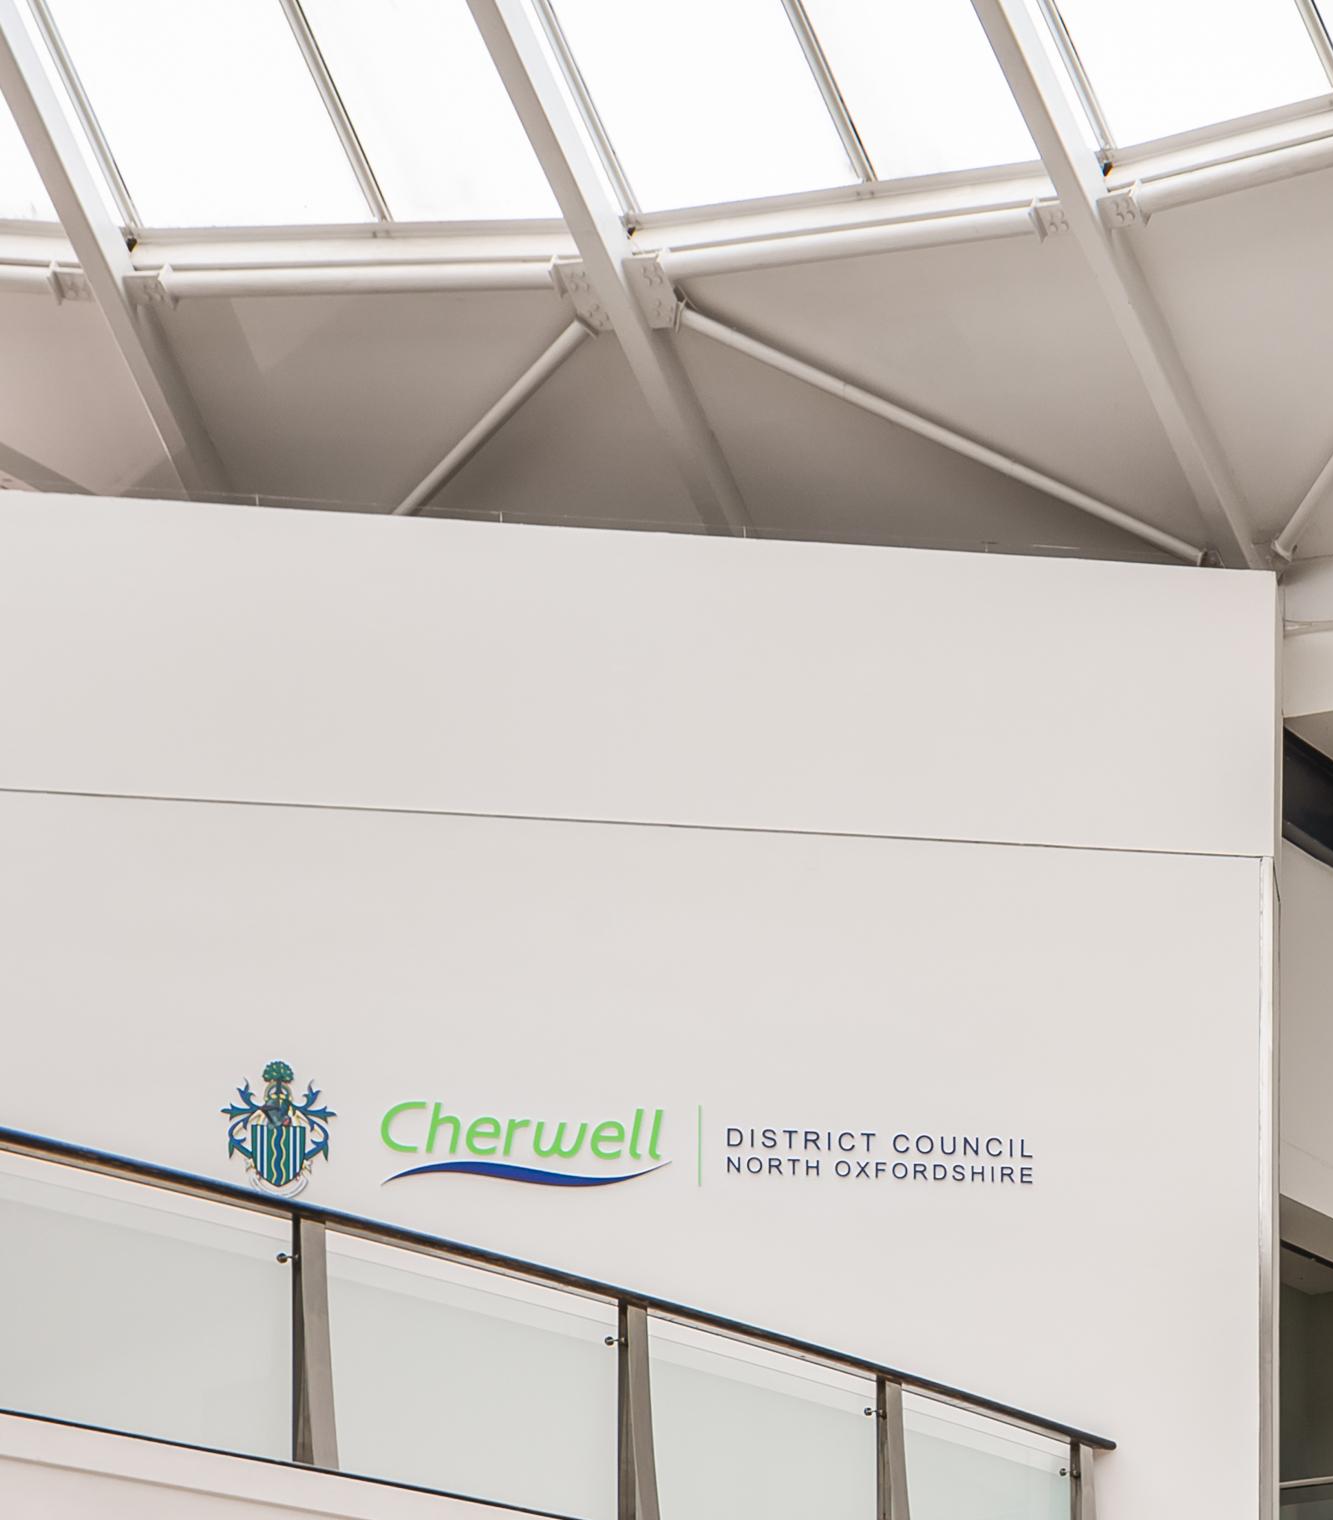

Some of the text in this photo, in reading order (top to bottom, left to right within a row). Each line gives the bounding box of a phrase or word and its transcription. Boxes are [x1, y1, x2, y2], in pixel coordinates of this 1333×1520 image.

[379, 1099, 666, 1162] Cherwell
[725, 1125, 1035, 1159] DISTRICT COUNCIL
[725, 1156, 1035, 1185] NORTH OXFORDSHIRE
